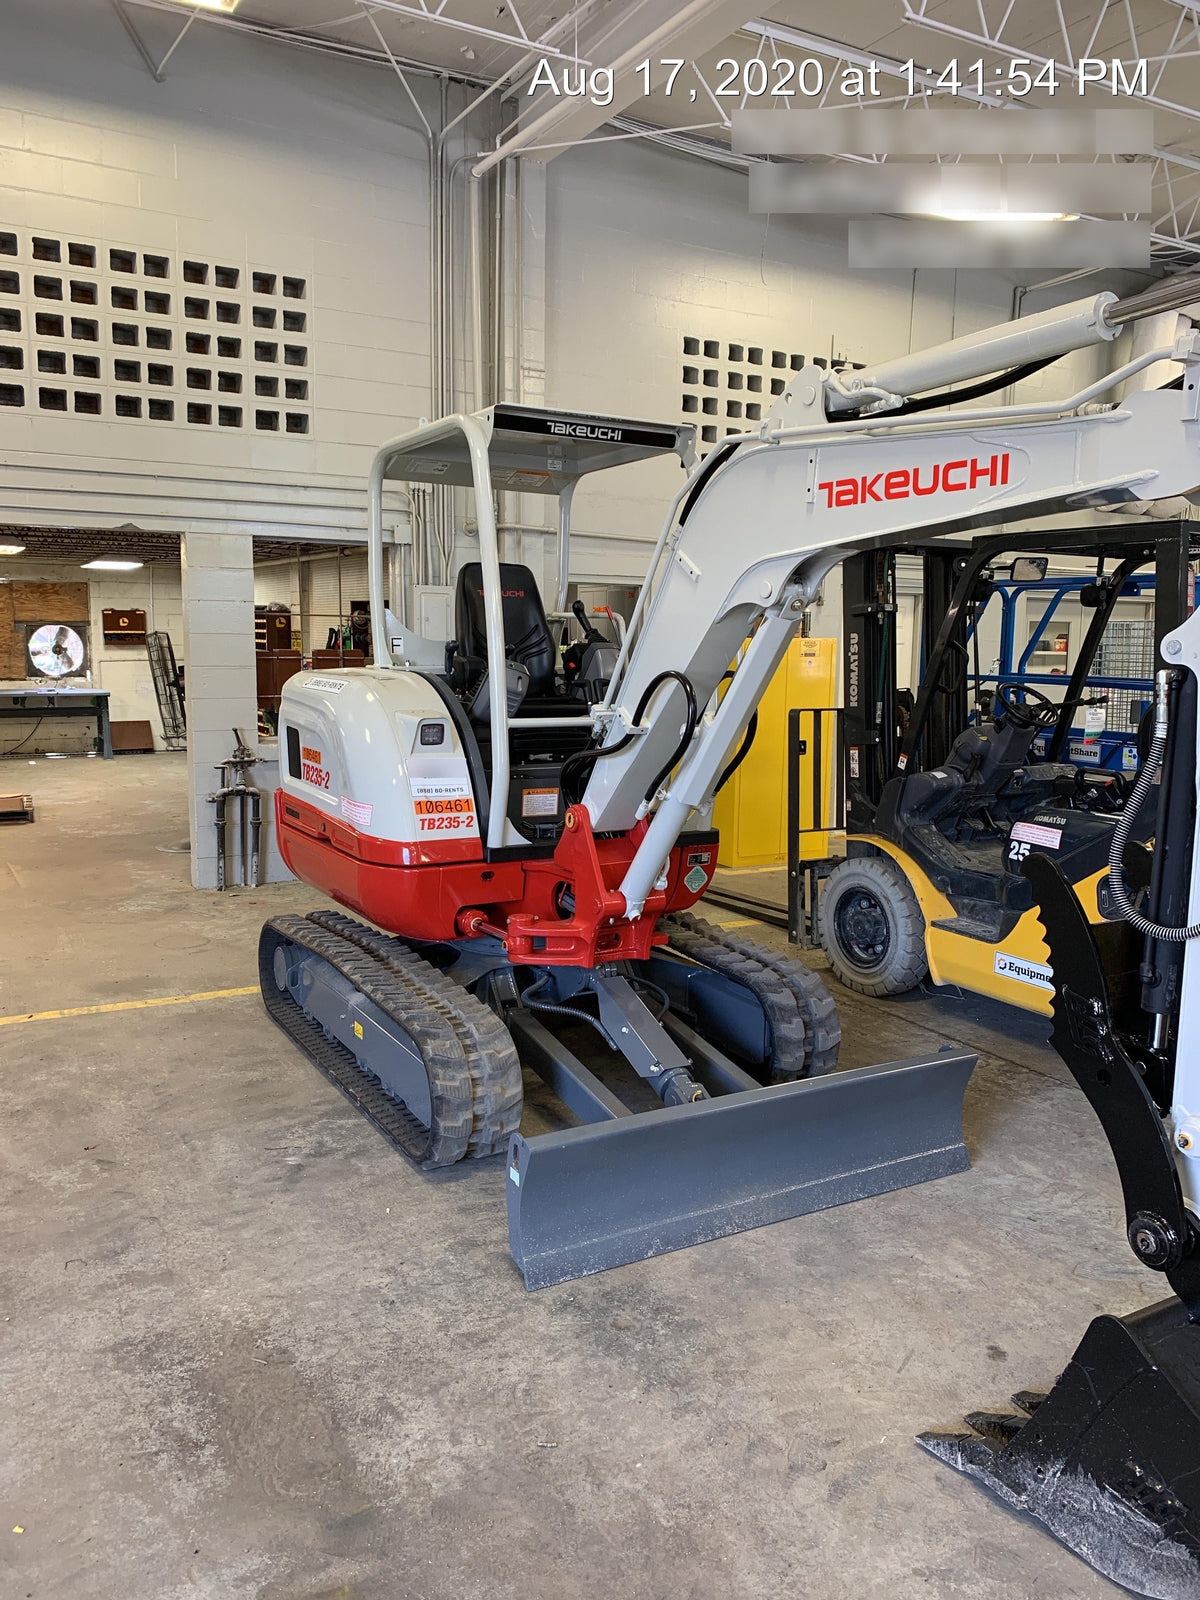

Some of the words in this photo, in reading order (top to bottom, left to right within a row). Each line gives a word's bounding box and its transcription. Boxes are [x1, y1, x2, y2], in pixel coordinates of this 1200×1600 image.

[546, 421, 622, 441] TAKEUCHI
[818, 453, 1010, 509] TAKEUCHI
[477, 588, 525, 597] TUCHI
[391, 637, 402, 653] F
[848, 632, 859, 708] KOMATSU
[302, 762, 330, 789] TB235-2
[416, 798, 471, 814] 106461
[420, 815, 474, 831] TB235-2
[1034, 815, 1067, 825] KOMATSU
